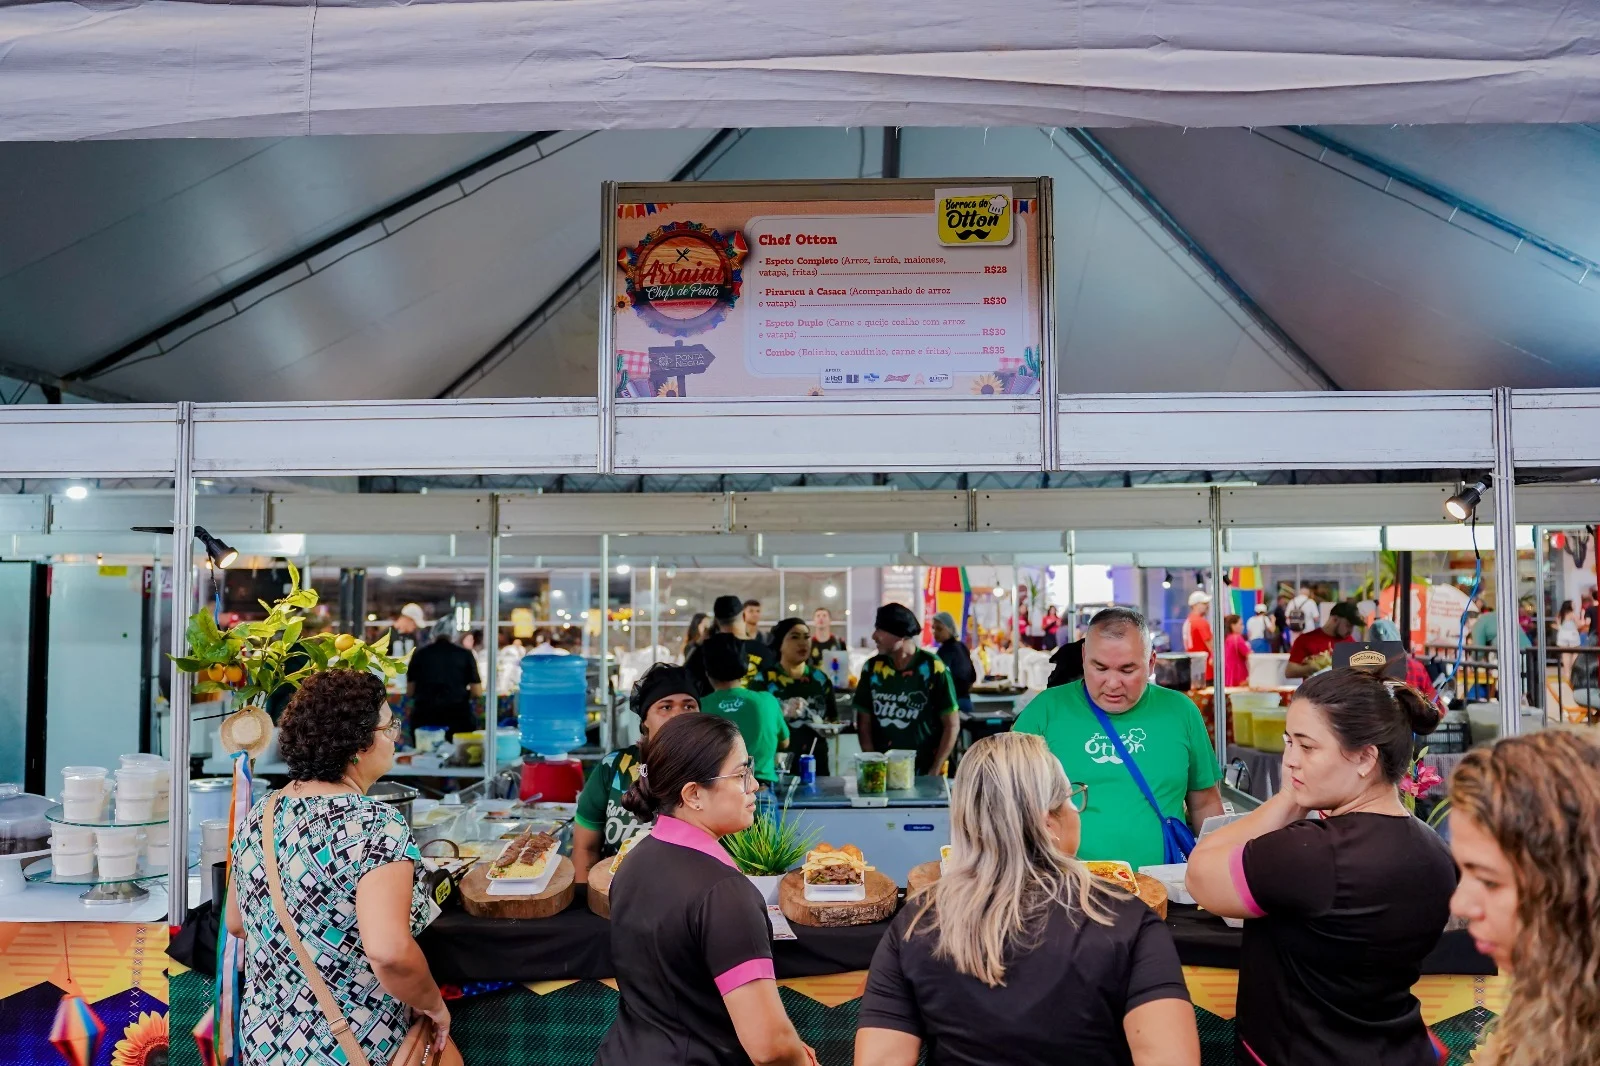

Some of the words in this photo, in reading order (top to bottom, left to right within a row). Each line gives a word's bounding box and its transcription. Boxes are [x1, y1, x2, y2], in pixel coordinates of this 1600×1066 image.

[945, 198, 976, 210] Barraca
[946, 209, 999, 228] Otton
[758, 233, 791, 246] Chef
[795, 233, 838, 245] Otton
[765, 257, 794, 267] Espeto
[796, 256, 839, 266] Completo
[841, 256, 871, 265] (Arroz,
[873, 255, 901, 264] farofa,
[904, 255, 946, 265] maionese,
[758, 268, 789, 277] vatapá,
[792, 267, 818, 277] fritas)
[983, 266, 1008, 274] R$28
[645, 285, 675, 301] Chefs
[676, 286, 688, 296] de
[689, 282, 719, 297] Ponta
[765, 288, 806, 296] Pirarucu
[816, 287, 847, 296] Casaca
[849, 286, 913, 297] (Acompanhado
[915, 287, 926, 295] de
[928, 287, 951, 295] arroz
[765, 299, 797, 308] vatapá)
[983, 297, 1007, 305] R$30
[765, 319, 794, 328] Espeto
[797, 319, 824, 328] Duplo
[826, 318, 855, 327] (Carne
[864, 318, 889, 327] queijo
[891, 318, 920, 326] coalho
[765, 331, 797, 340] vatapá)
[982, 328, 1006, 336] R$30
[765, 348, 796, 357] Combo
[925, 346, 952, 356] fritas)
[982, 346, 1005, 355] R$35
[675, 353, 704, 362] PONTA
[675, 360, 705, 368] NEGRA
[873, 700, 919, 719] Otton
